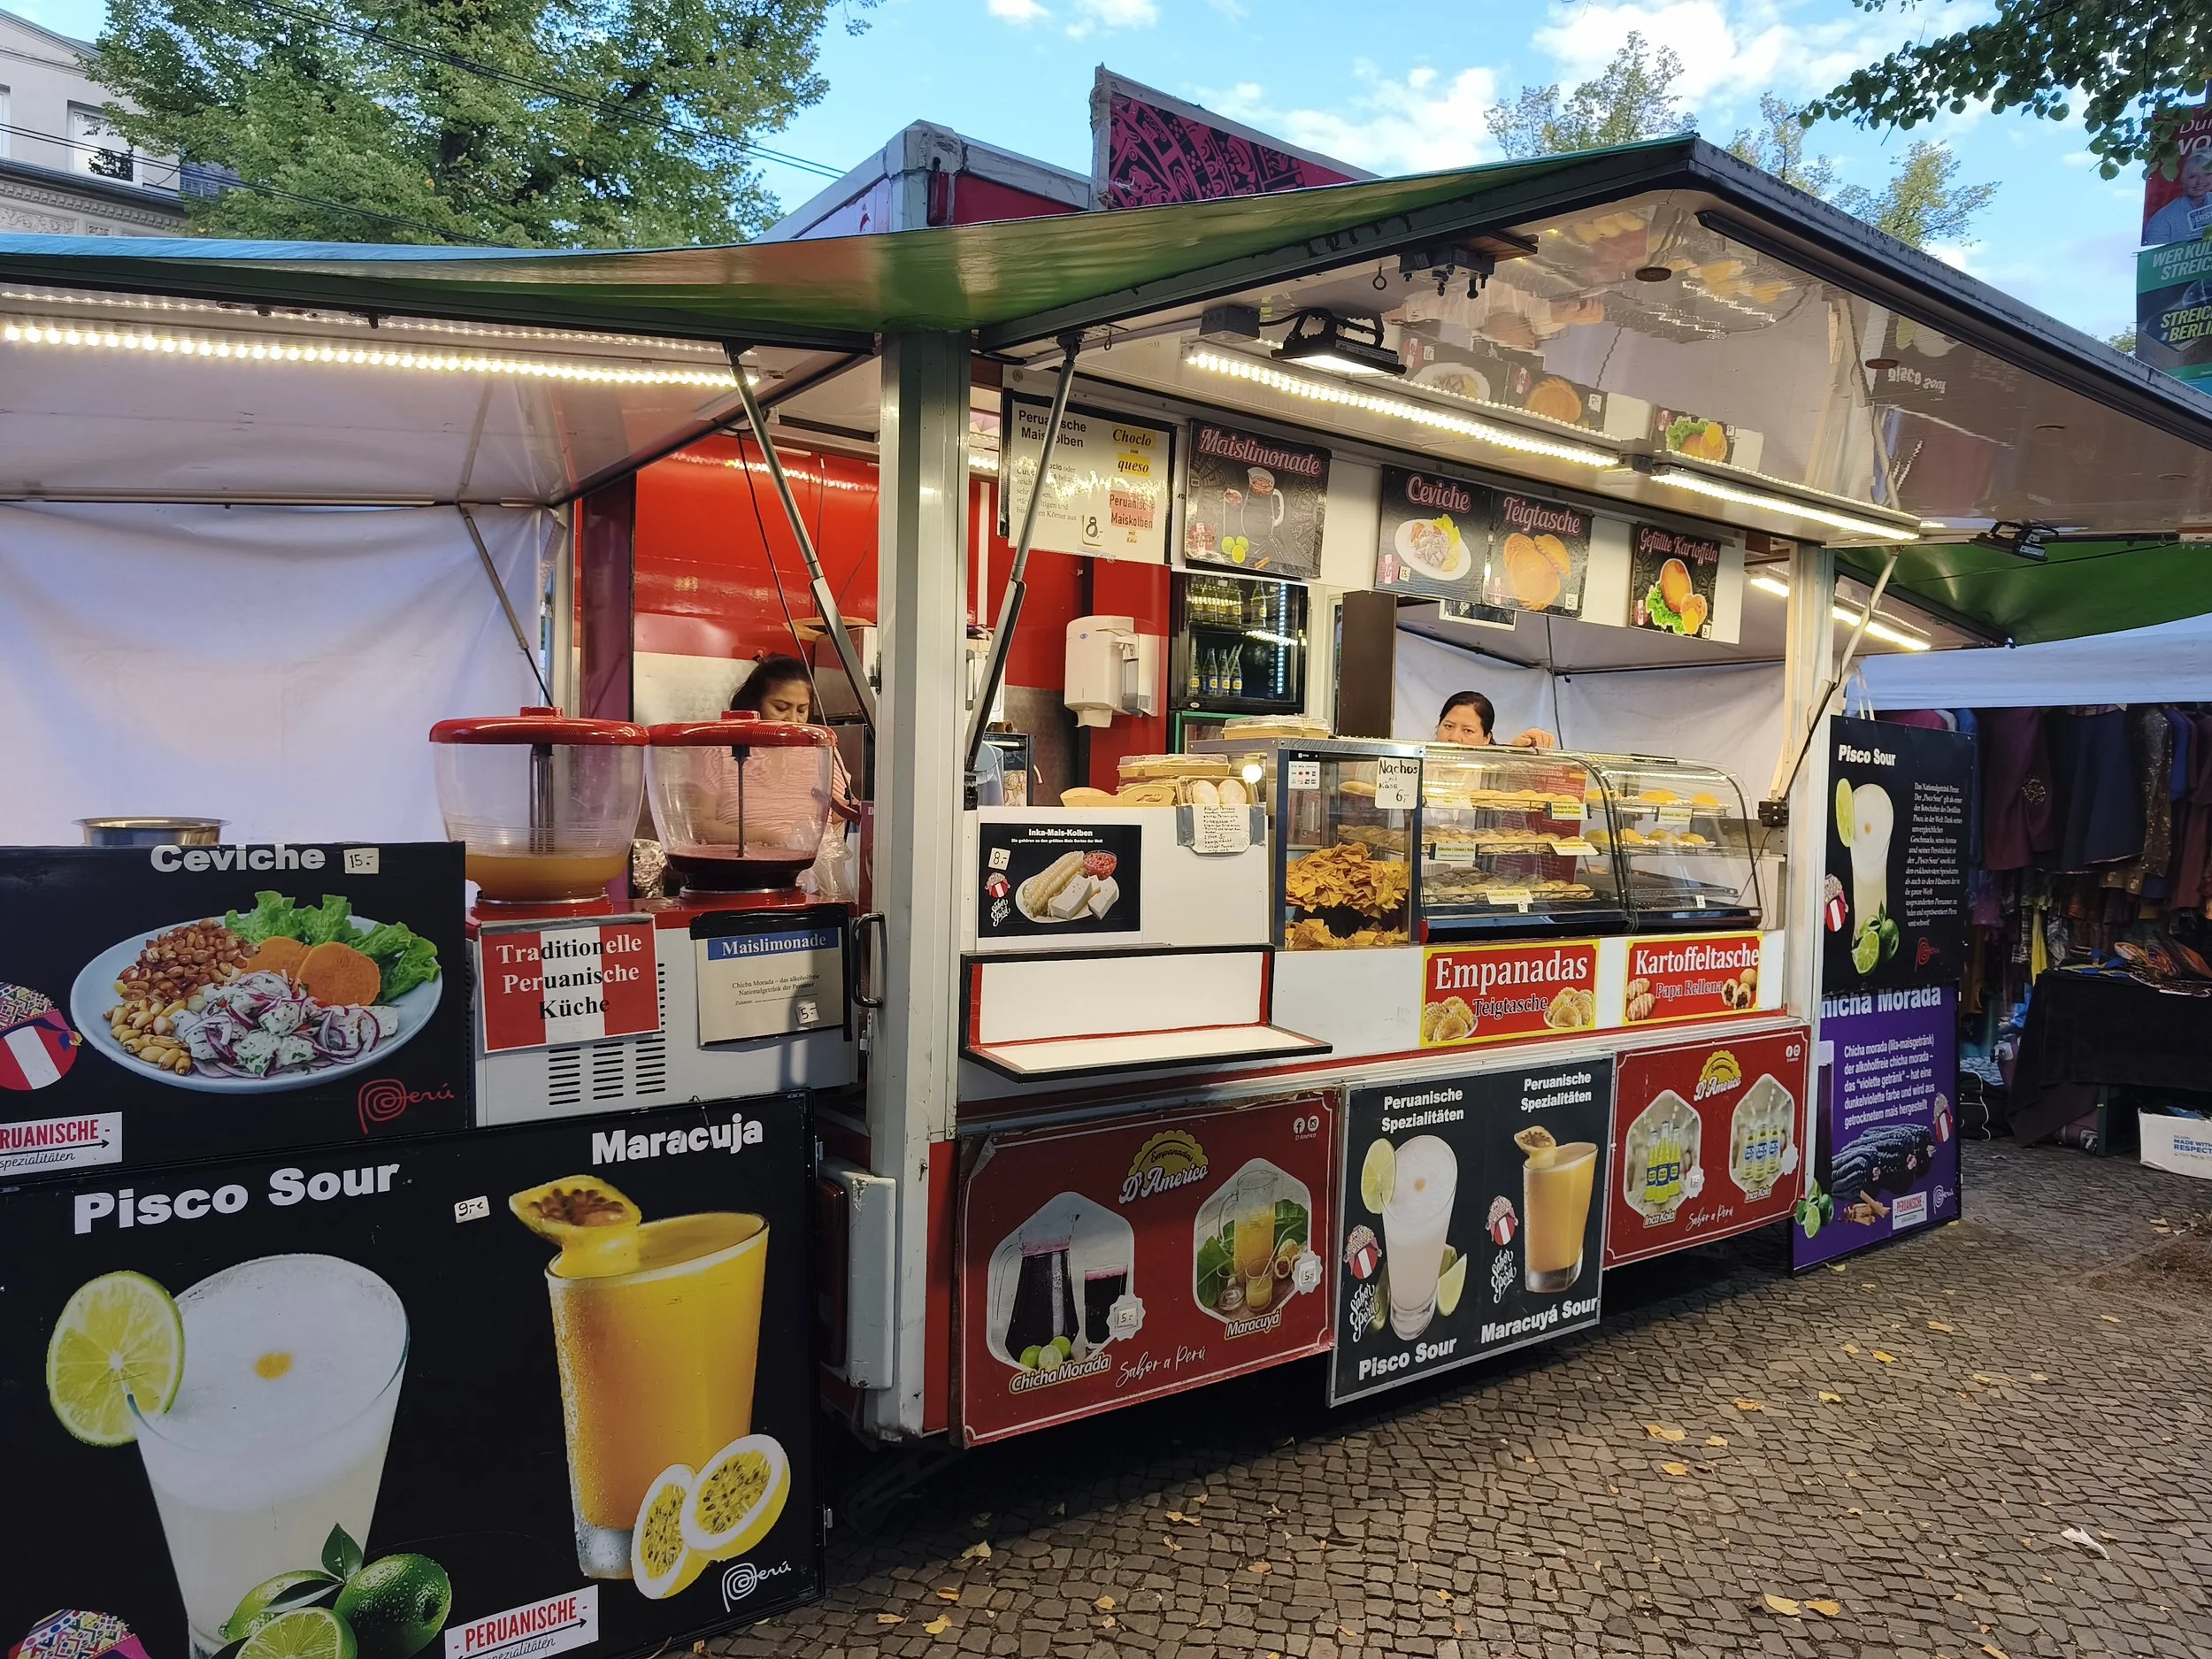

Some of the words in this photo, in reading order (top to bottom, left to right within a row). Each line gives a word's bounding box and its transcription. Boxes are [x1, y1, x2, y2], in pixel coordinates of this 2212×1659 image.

[2152, 251, 2182, 268] WER
[1018, 410, 1087, 432] Peruasche
[1021, 426, 1084, 448] Maisolben
[1112, 428, 1152, 446] Choclo
[1200, 428, 1321, 476] Maislimonade
[1118, 460, 1149, 472] queso
[1110, 494, 1156, 511] Peruanische
[1407, 475, 1470, 511] Ceviche
[1110, 512, 1153, 529] Maiskolben
[1503, 496, 1580, 534] Teigtasche
[1640, 527, 1672, 553] Gefüllte
[1673, 536, 1718, 565] Kartoffeln
[1379, 759, 1417, 775] Nachos
[1838, 744, 1871, 764] Pisco
[1873, 748, 1896, 767] Sour
[1379, 780, 1398, 789] Käse
[1028, 828, 1094, 837] Inka-Mais-Kolben
[150, 843, 326, 873] Ceviche
[495, 933, 643, 965] Traditionelle
[722, 933, 826, 956] Maislimonade
[1635, 943, 1760, 976] Kartoffeltasche
[502, 964, 641, 995] Peruanische
[732, 980, 752, 989] Chicha
[753, 979, 774, 987] Morada
[790, 973, 820, 983] alkoholfreie
[1434, 950, 1588, 996] Empanadas
[738, 986, 781, 996] Nationalgetränk
[792, 981, 815, 990] Peruaner
[1655, 982, 1682, 1002] Papa
[1684, 979, 1724, 995] Rellena
[1878, 984, 1941, 1012] Morada
[538, 995, 611, 1021] Küche
[1472, 992, 1548, 1020] Teigtasche
[1844, 1043, 1865, 1058] Chicha
[1866, 1041, 1887, 1055] morada
[1887, 1033, 1934, 1054] (lila-maisgetränk)
[1844, 1063, 1855, 1075] der
[1855, 1058, 1889, 1074] alkoholfreie
[1889, 1055, 1908, 1068] chicha
[1909, 1051, 1929, 1064] morada
[1524, 1071, 1592, 1093] Peruanische
[1844, 1079, 1855, 1093] das
[1911, 1068, 1920, 1079] hat
[1920, 1067, 1932, 1078] eine
[1383, 1087, 1463, 1111] Peruanische
[1520, 1089, 1592, 1113] Spezialitäten
[1844, 1092, 1885, 1110] dunkelviolette
[1886, 1088, 1901, 1101] farbe
[1901, 1086, 1912, 1097] und
[1912, 1082, 1924, 1095] wird
[1925, 1083, 1935, 1093] aus
[1381, 1107, 1464, 1134] Spezialitäten
[1885, 1104, 1899, 1118] mais
[592, 1112, 764, 1165] Maracuja
[2173, 1143, 2212, 1155] RESPECT
[1151, 1149, 1193, 1164] Empanadas
[73, 1184, 250, 1235] Pisco
[269, 1161, 400, 1209] Sour
[1226, 1310, 1280, 1339] Maracuyá
[1480, 1303, 1558, 1344] Maracuyá
[1561, 1296, 1600, 1320] Sour
[1116, 1351, 1162, 1388] Sabor
[1164, 1359, 1171, 1370] a
[1175, 1345, 1207, 1371] Perú
[1358, 1354, 1410, 1381] Pisco
[1415, 1335, 1457, 1363] Sour
[1010, 1367, 1058, 1394] Chicha
[1056, 1353, 1111, 1380] Morada
[721, 1560, 792, 1612] Perú
[465, 1596, 577, 1652] PERUANISCHE
